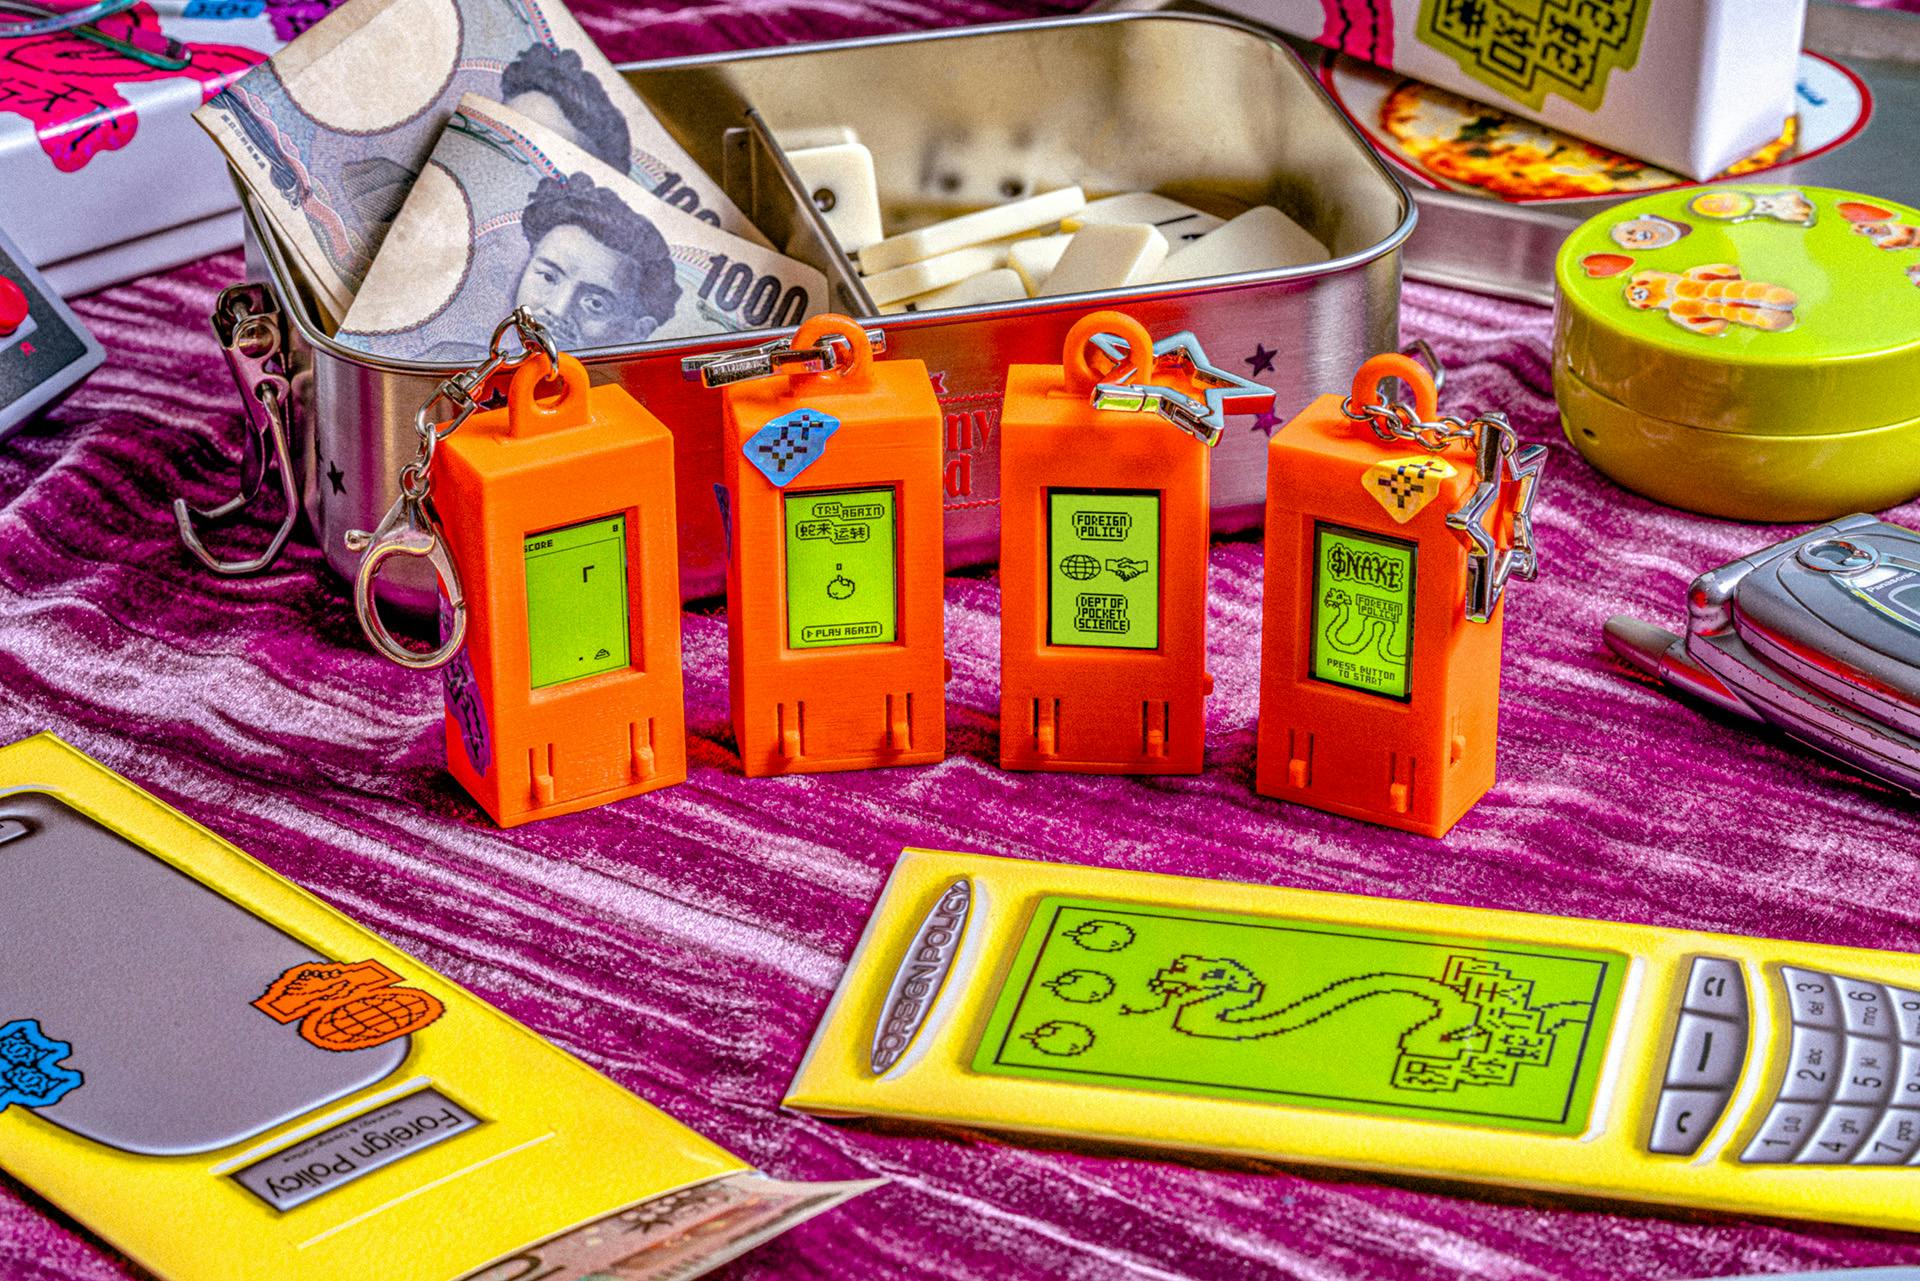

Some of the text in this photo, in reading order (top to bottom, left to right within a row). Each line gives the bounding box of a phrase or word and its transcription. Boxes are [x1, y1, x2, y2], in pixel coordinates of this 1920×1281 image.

[697, 254, 809, 328] 1000
[817, 505, 881, 518] TRY AGAIN
[1077, 515, 1127, 527] FOREIGN
[800, 523, 866, 541] 蛇来运转
[1080, 527, 1123, 538] POLICY
[524, 539, 553, 553] SCORE
[1331, 546, 1400, 588] $NAKE
[1866, 571, 1917, 593] Panasonic
[1080, 597, 1124, 608] DEPT OF
[1359, 597, 1400, 613] FOREIGN
[1082, 608, 1122, 619] POCKET
[1361, 605, 1396, 620] POLICY
[816, 626, 878, 638] PLAY AGAIN
[1079, 619, 1126, 631] SCIENCE
[1327, 658, 1395, 680] PRESS BUTTON
[1339, 669, 1383, 686] TO START
[874, 886, 969, 1066] FOREIGN POLICY
[1796, 982, 1824, 994] 3
[1848, 991, 1878, 1027] mno 6
[1796, 1049, 1826, 1082] 2 abc
[1853, 1057, 1882, 1088] 5 jkl
[1762, 1138, 1791, 1147] 1
[1818, 1118, 1859, 1153] 4 ghi
[265, 1108, 463, 1198] Foreign Policy
[1874, 1141, 1903, 1154] 7
